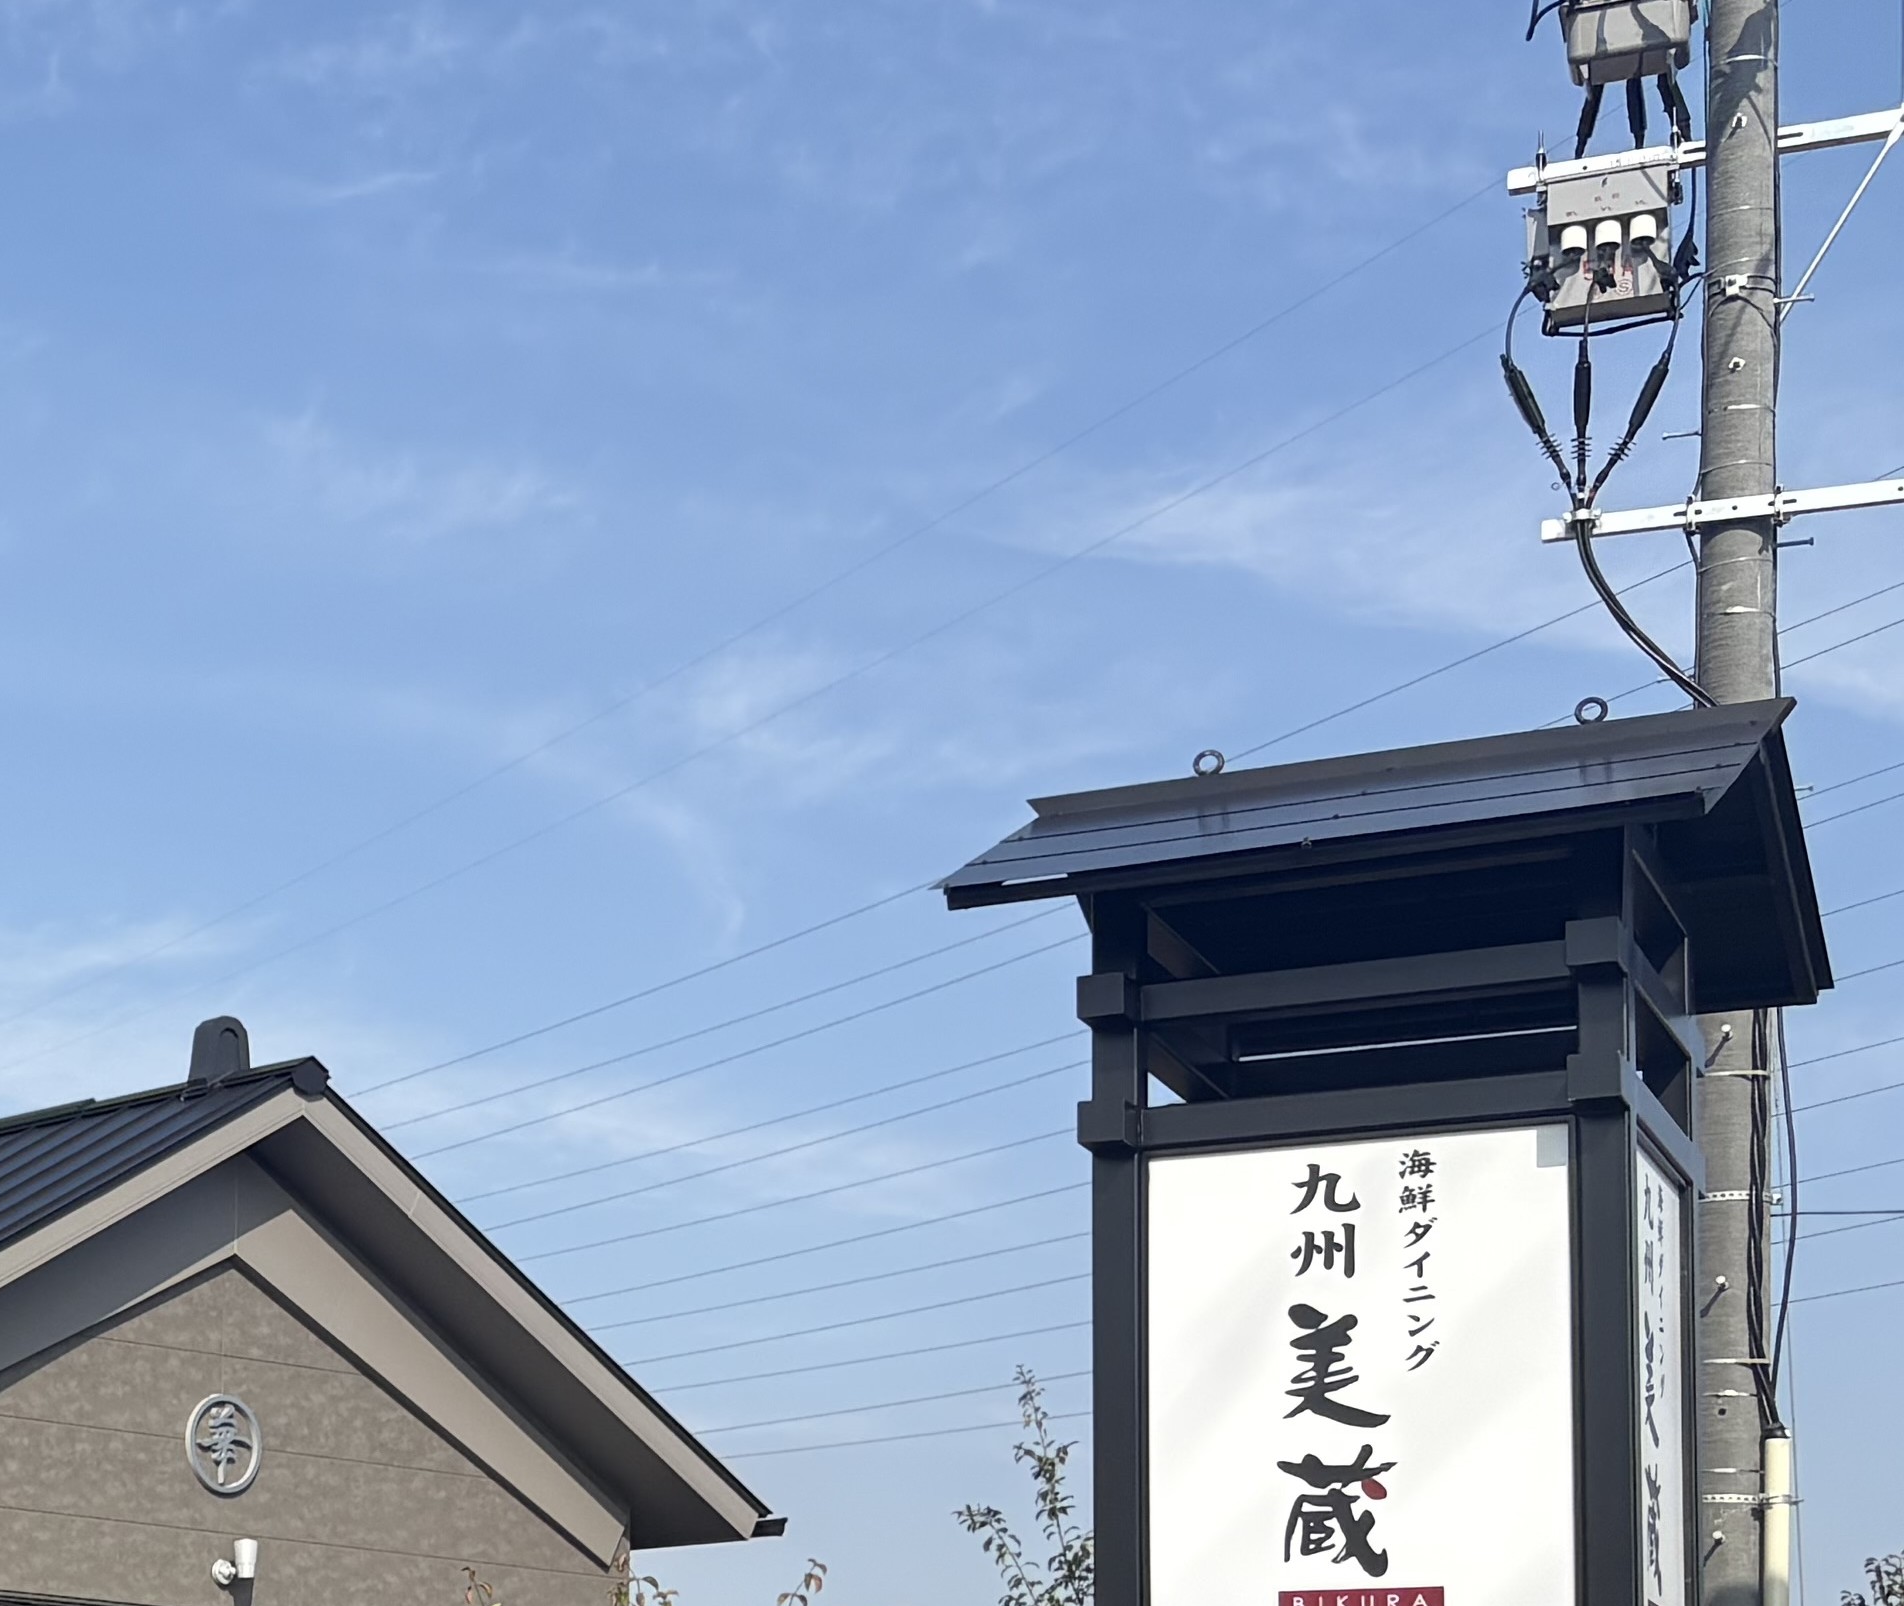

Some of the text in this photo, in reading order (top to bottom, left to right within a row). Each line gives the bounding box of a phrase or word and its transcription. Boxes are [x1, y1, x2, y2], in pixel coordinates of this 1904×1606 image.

[1277, 1163, 1396, 1578] 九州美蔵
[1398, 1149, 1440, 1372] 海鮮ダイニング
